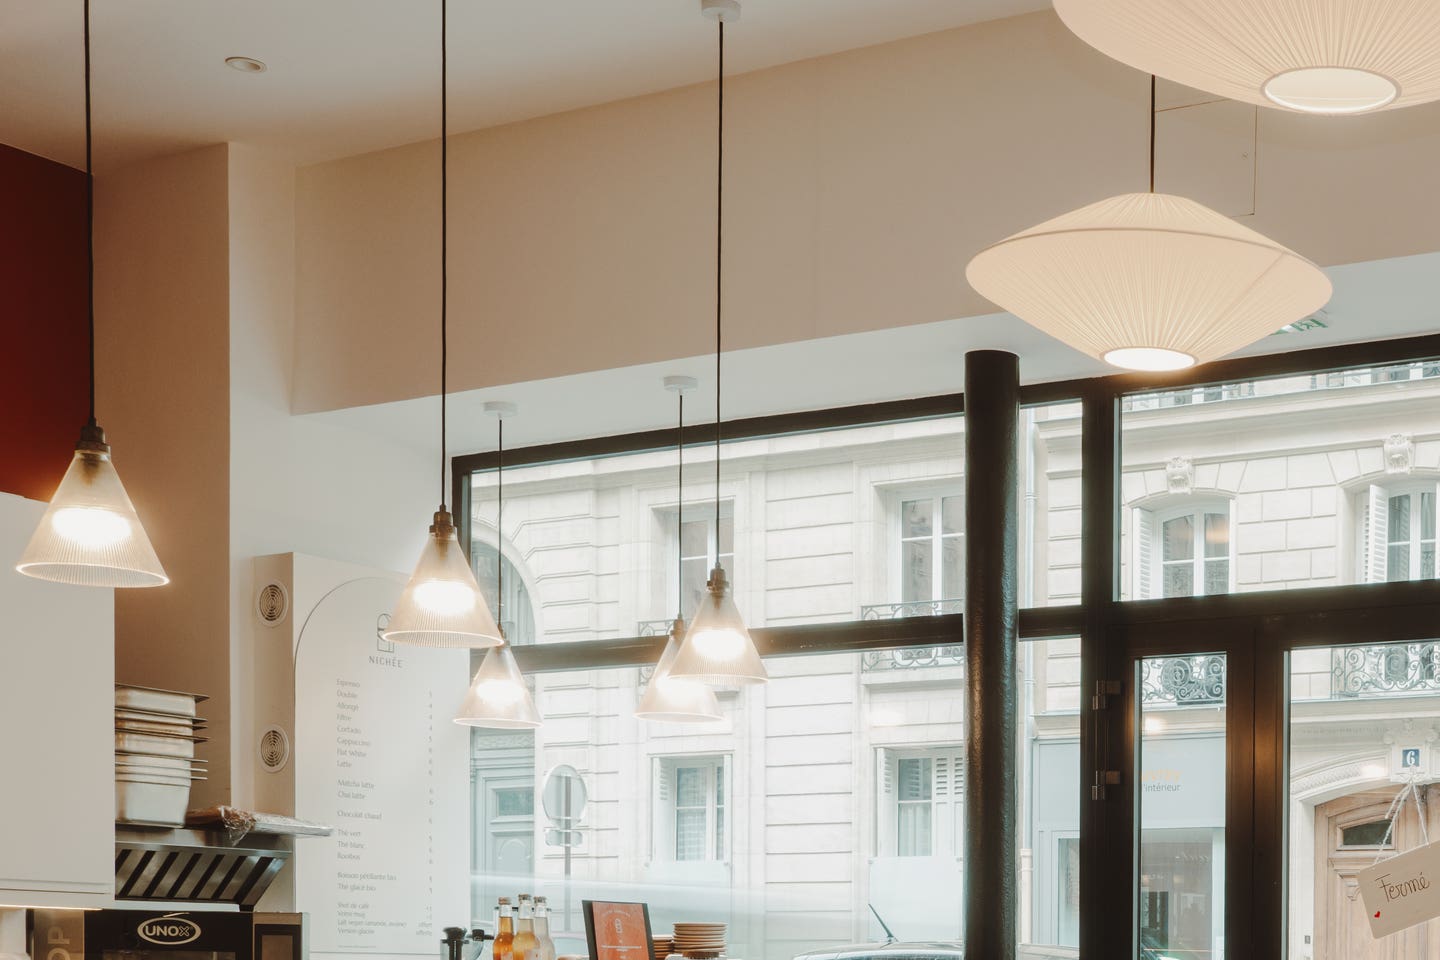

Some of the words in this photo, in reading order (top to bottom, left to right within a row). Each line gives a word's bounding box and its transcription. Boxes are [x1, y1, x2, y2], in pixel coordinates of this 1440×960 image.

[1406, 750, 1416, 765] 6
[1374, 871, 1431, 903] Fermé
[145, 925, 190, 937] UNOX
